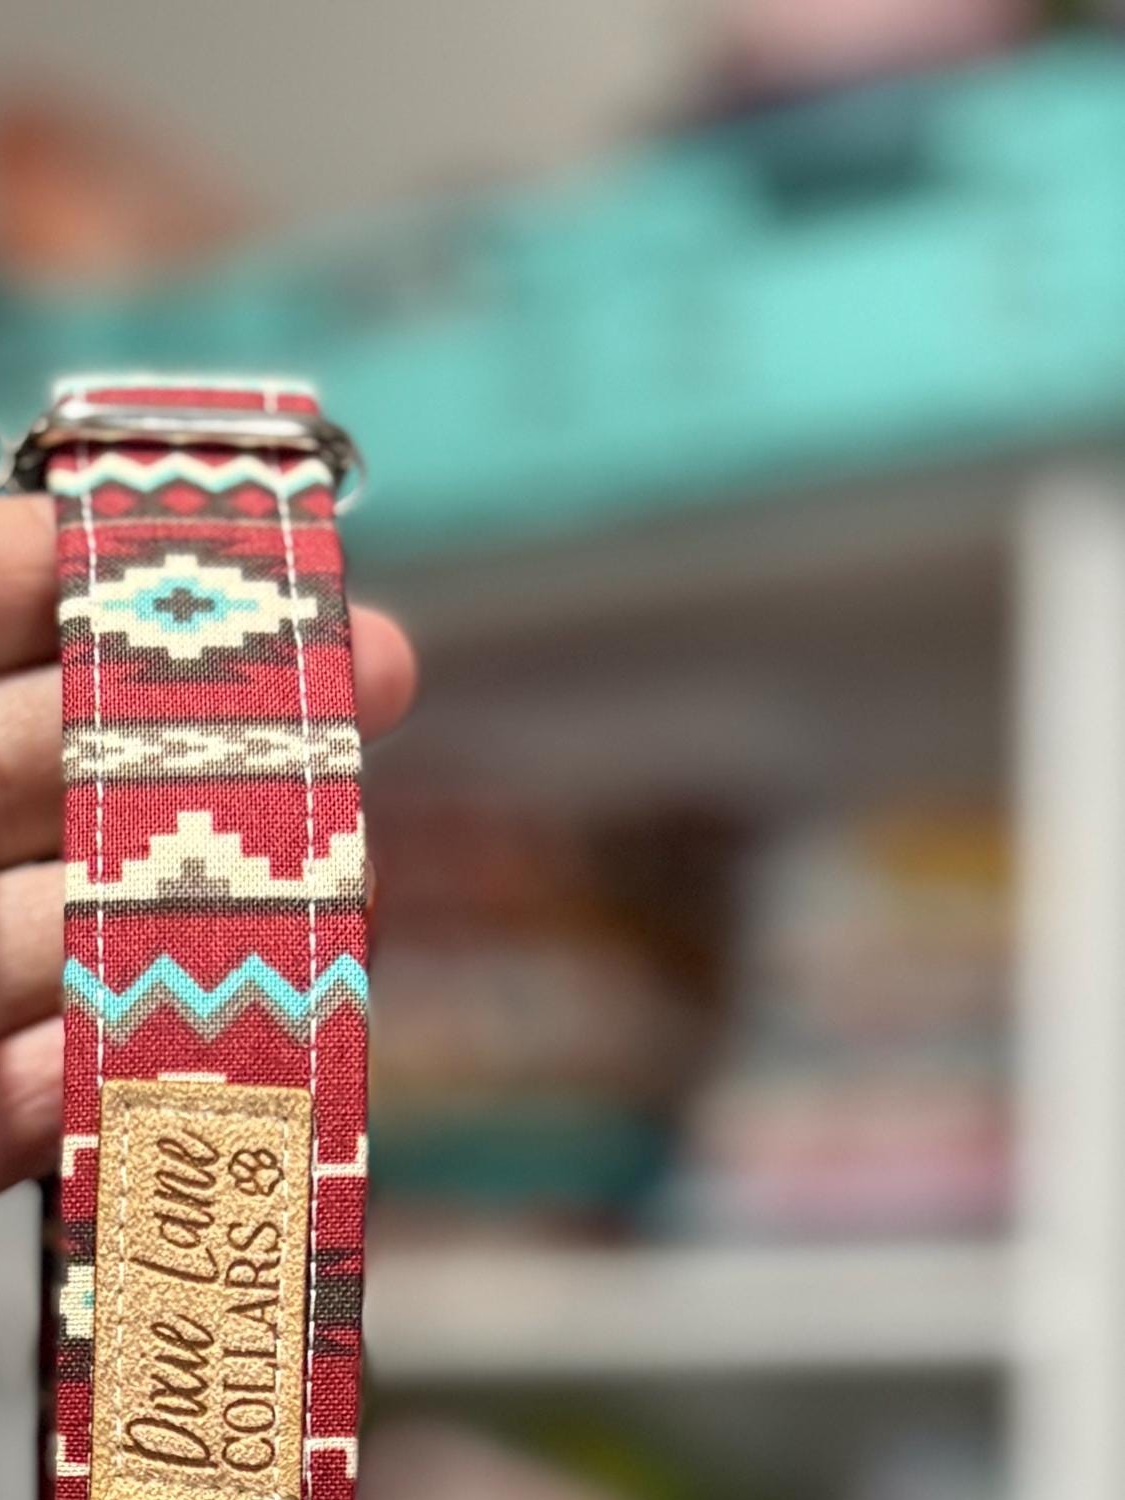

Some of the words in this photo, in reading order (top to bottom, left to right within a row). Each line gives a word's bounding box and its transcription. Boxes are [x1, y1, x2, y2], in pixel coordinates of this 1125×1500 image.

[130, 1129, 221, 1285] Lane
[122, 1313, 219, 1470] Dixie
[221, 1220, 283, 1472] COLLARS
